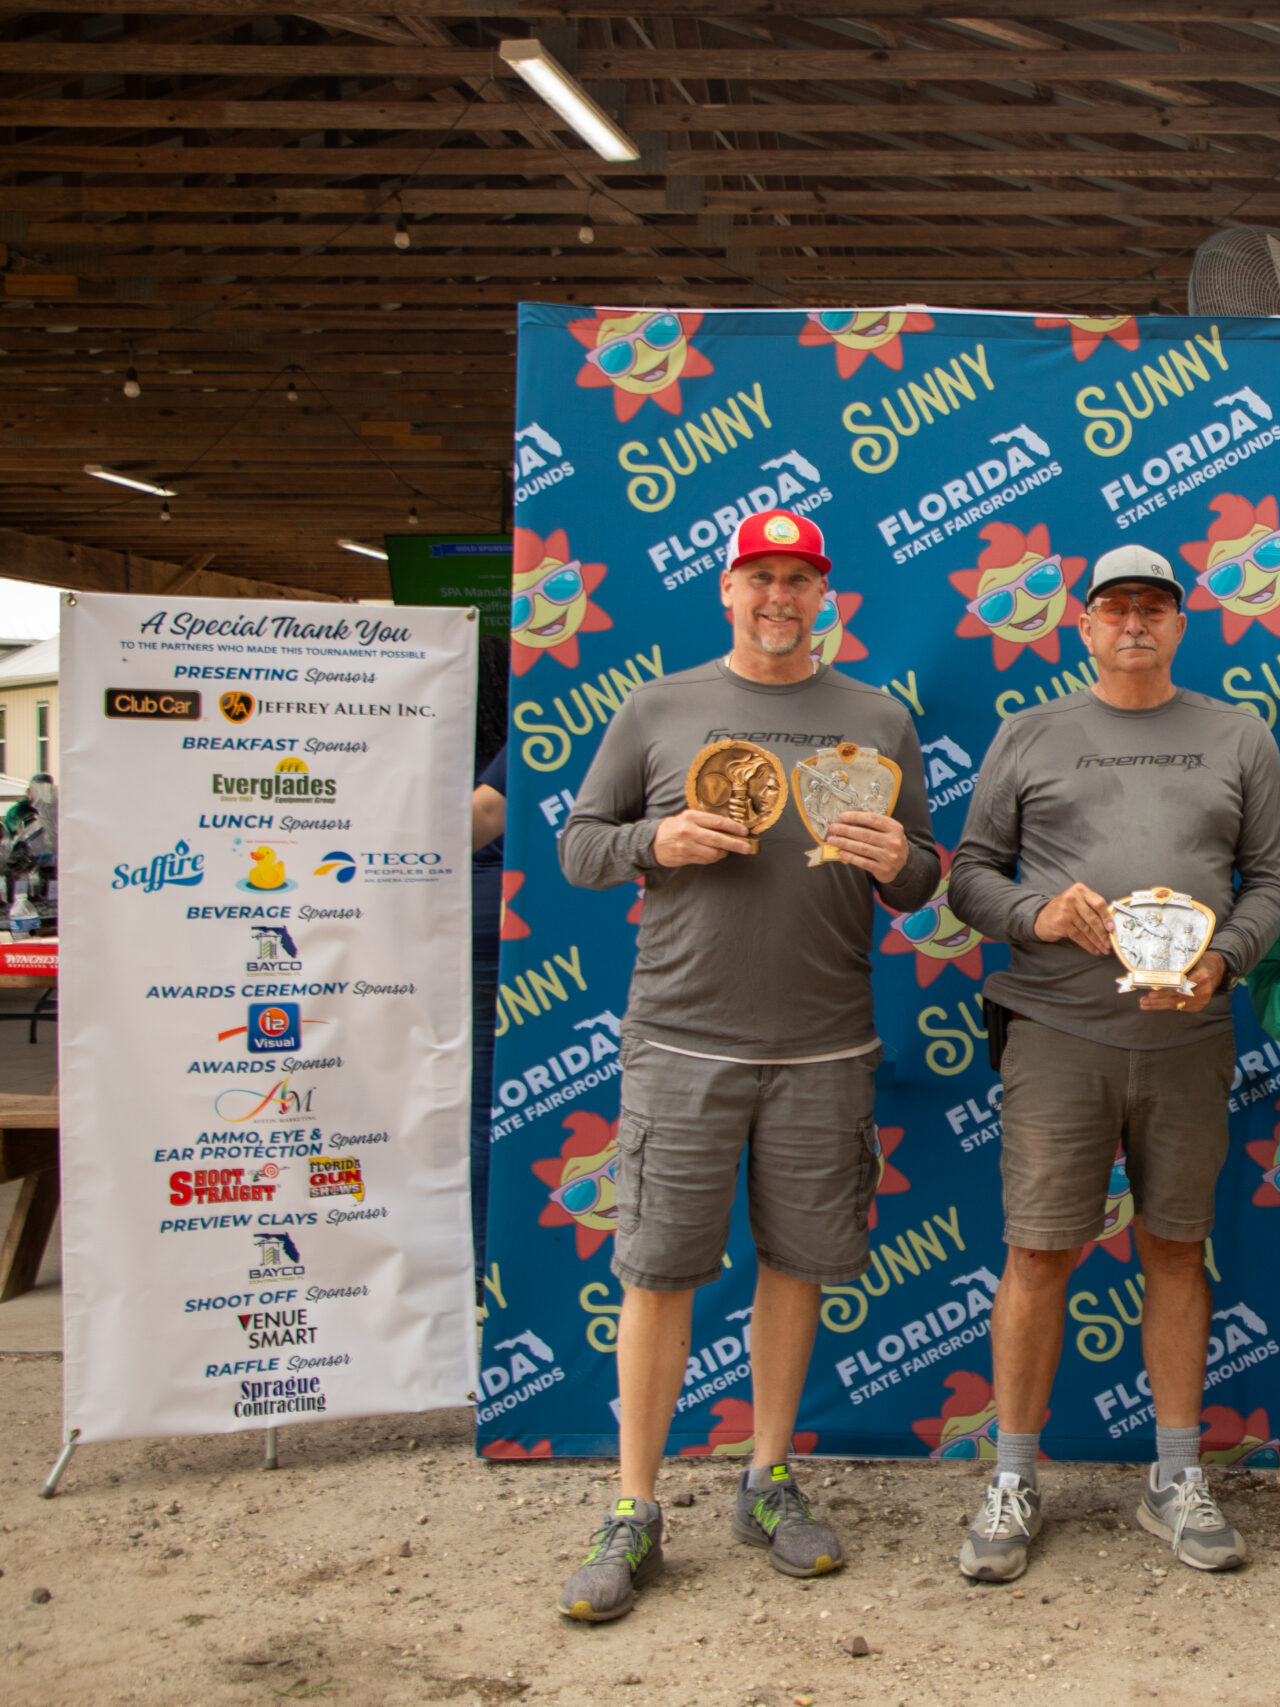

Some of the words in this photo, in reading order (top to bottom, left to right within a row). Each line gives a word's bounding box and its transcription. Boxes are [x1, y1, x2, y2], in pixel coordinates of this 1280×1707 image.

[618, 382, 773, 513] SUNNY
[878, 445, 1036, 547] FLORIDA
[892, 524, 946, 565] STATE
[941, 462, 1064, 536] FAIRGROUNDS
[141, 612, 168, 635] A
[169, 612, 266, 640] Special
[270, 617, 351, 640] Thank
[355, 620, 411, 645] You
[119, 640, 136, 649] TO
[137, 641, 158, 650] THE
[159, 642, 215, 651] PARTNERS
[245, 645, 278, 653] MADE
[305, 648, 378, 657] TOURNAMENT
[379, 650, 425, 658] POSSIBLE
[174, 665, 298, 682] PRESENTING
[304, 669, 377, 685] Sponsors
[115, 697, 158, 714] Club
[160, 698, 191, 715] Car
[182, 736, 299, 751] BREAKFAST
[304, 738, 369, 754] Sponsor
[212, 774, 336, 800] Everglades
[198, 814, 274, 829] LUNCH
[280, 816, 352, 832] Sponsors
[112, 839, 205, 893] Saffire
[361, 852, 441, 866] TECO
[186, 905, 291, 920] BEVERAGE
[298, 905, 363, 921] Sponsor
[247, 962, 302, 971] BAYCO
[145, 985, 236, 999] AWARDS
[240, 981, 349, 998] CEREMONY
[353, 982, 416, 997] Sponsor
[255, 1037, 294, 1049] Visual
[187, 1059, 276, 1074] AWARDS
[281, 1056, 344, 1073] Sponsor
[195, 1131, 263, 1149] AMMO,
[269, 1129, 308, 1147] EYE
[309, 1127, 323, 1146] &
[329, 1130, 390, 1149] Sponsor
[153, 1147, 195, 1163] EAR
[200, 1140, 324, 1161] PROTECTION
[310, 1158, 361, 1172] FLORIDA
[310, 1170, 361, 1185] GUN
[159, 1214, 253, 1234] PREVIEW
[257, 1212, 318, 1226] CLAYS
[326, 1206, 389, 1225] Sponsor
[250, 1266, 305, 1279] BAYCO
[184, 1293, 255, 1313] SHOOT
[258, 1289, 298, 1305] OFF
[305, 1285, 369, 1302] Sponsor
[249, 1327, 318, 1349] SMART
[205, 1357, 280, 1378] RAFFLE
[287, 1353, 351, 1371] Sponsor
[241, 1376, 320, 1400] Sprague
[234, 1395, 326, 1418] Contracting
